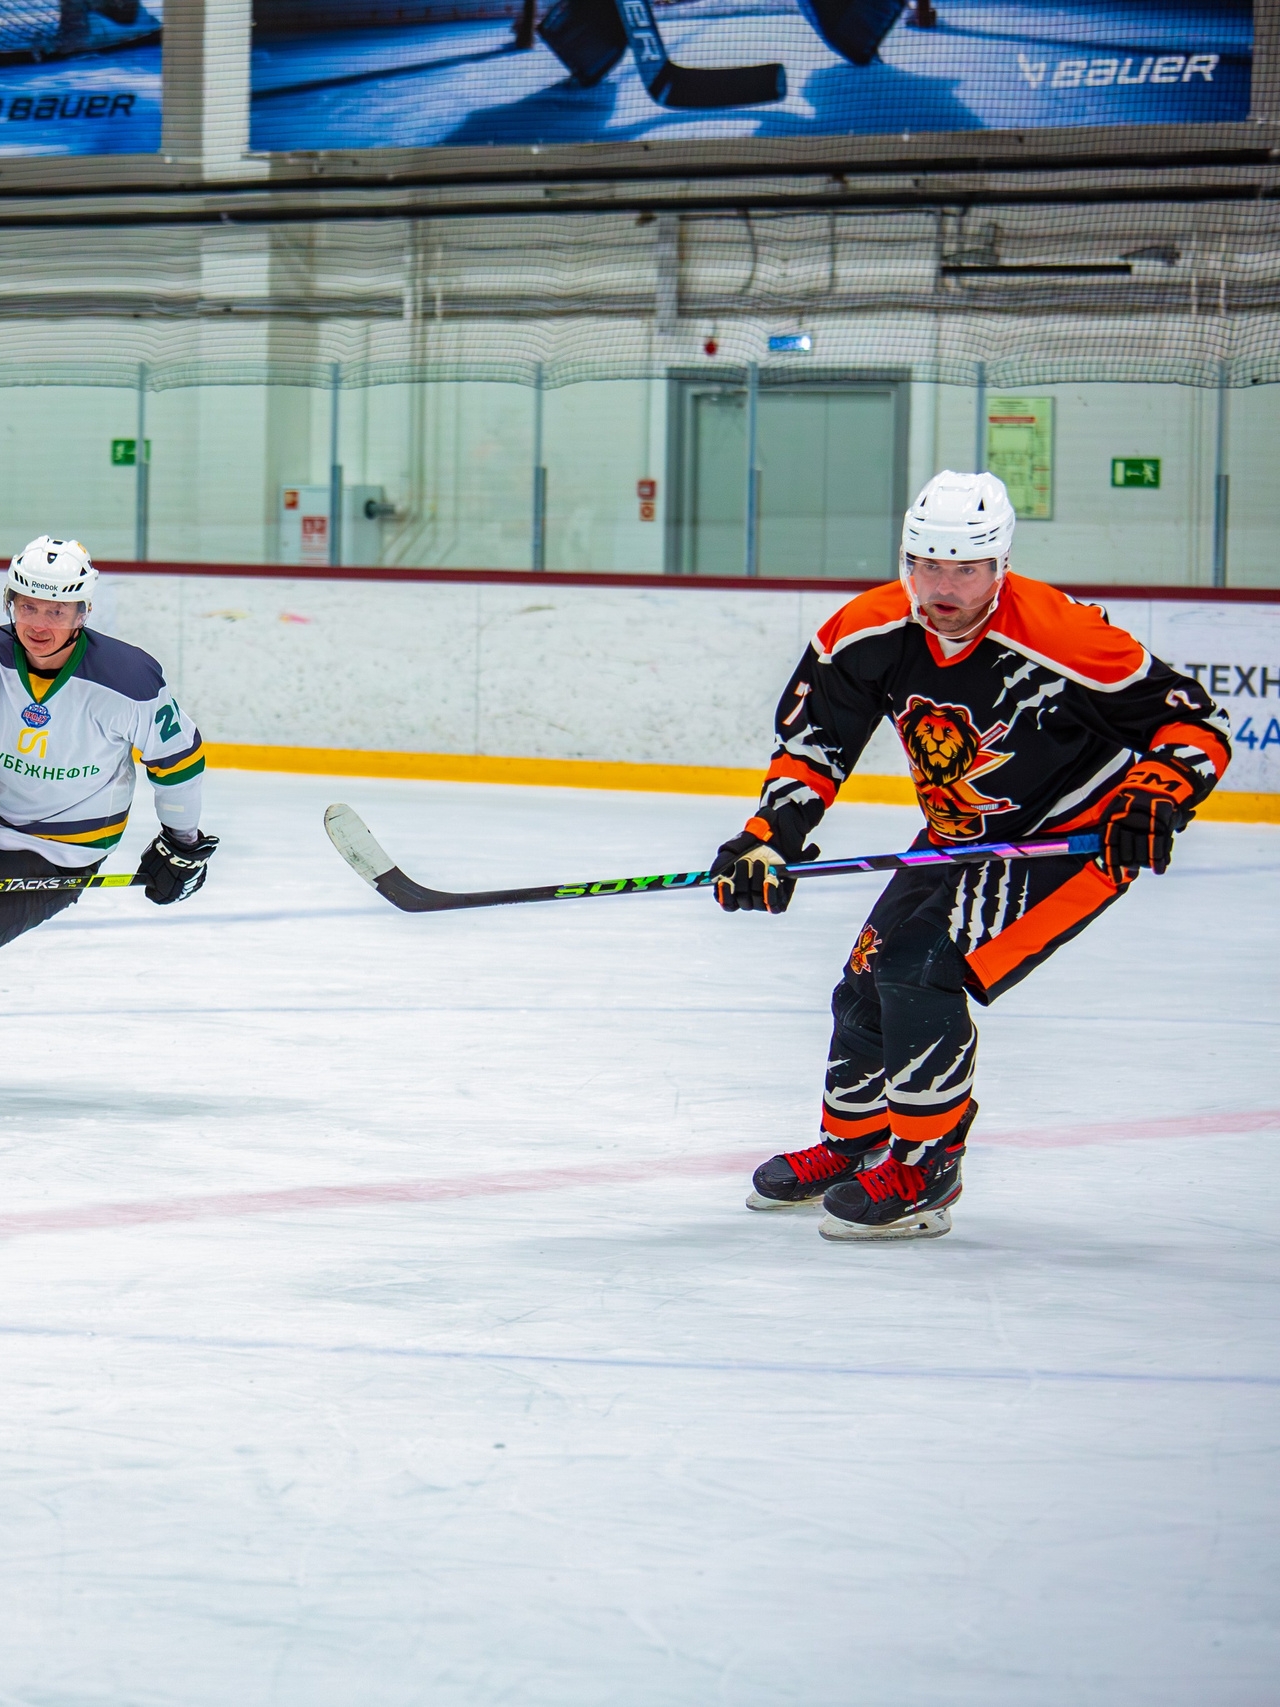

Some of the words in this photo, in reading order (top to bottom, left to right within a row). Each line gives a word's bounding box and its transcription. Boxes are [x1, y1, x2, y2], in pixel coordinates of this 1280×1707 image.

[31, 580, 59, 592] Reebok
[154, 697, 182, 743] 2
[155, 841, 210, 869] CCM
[5, 876, 60, 892] TACKS
